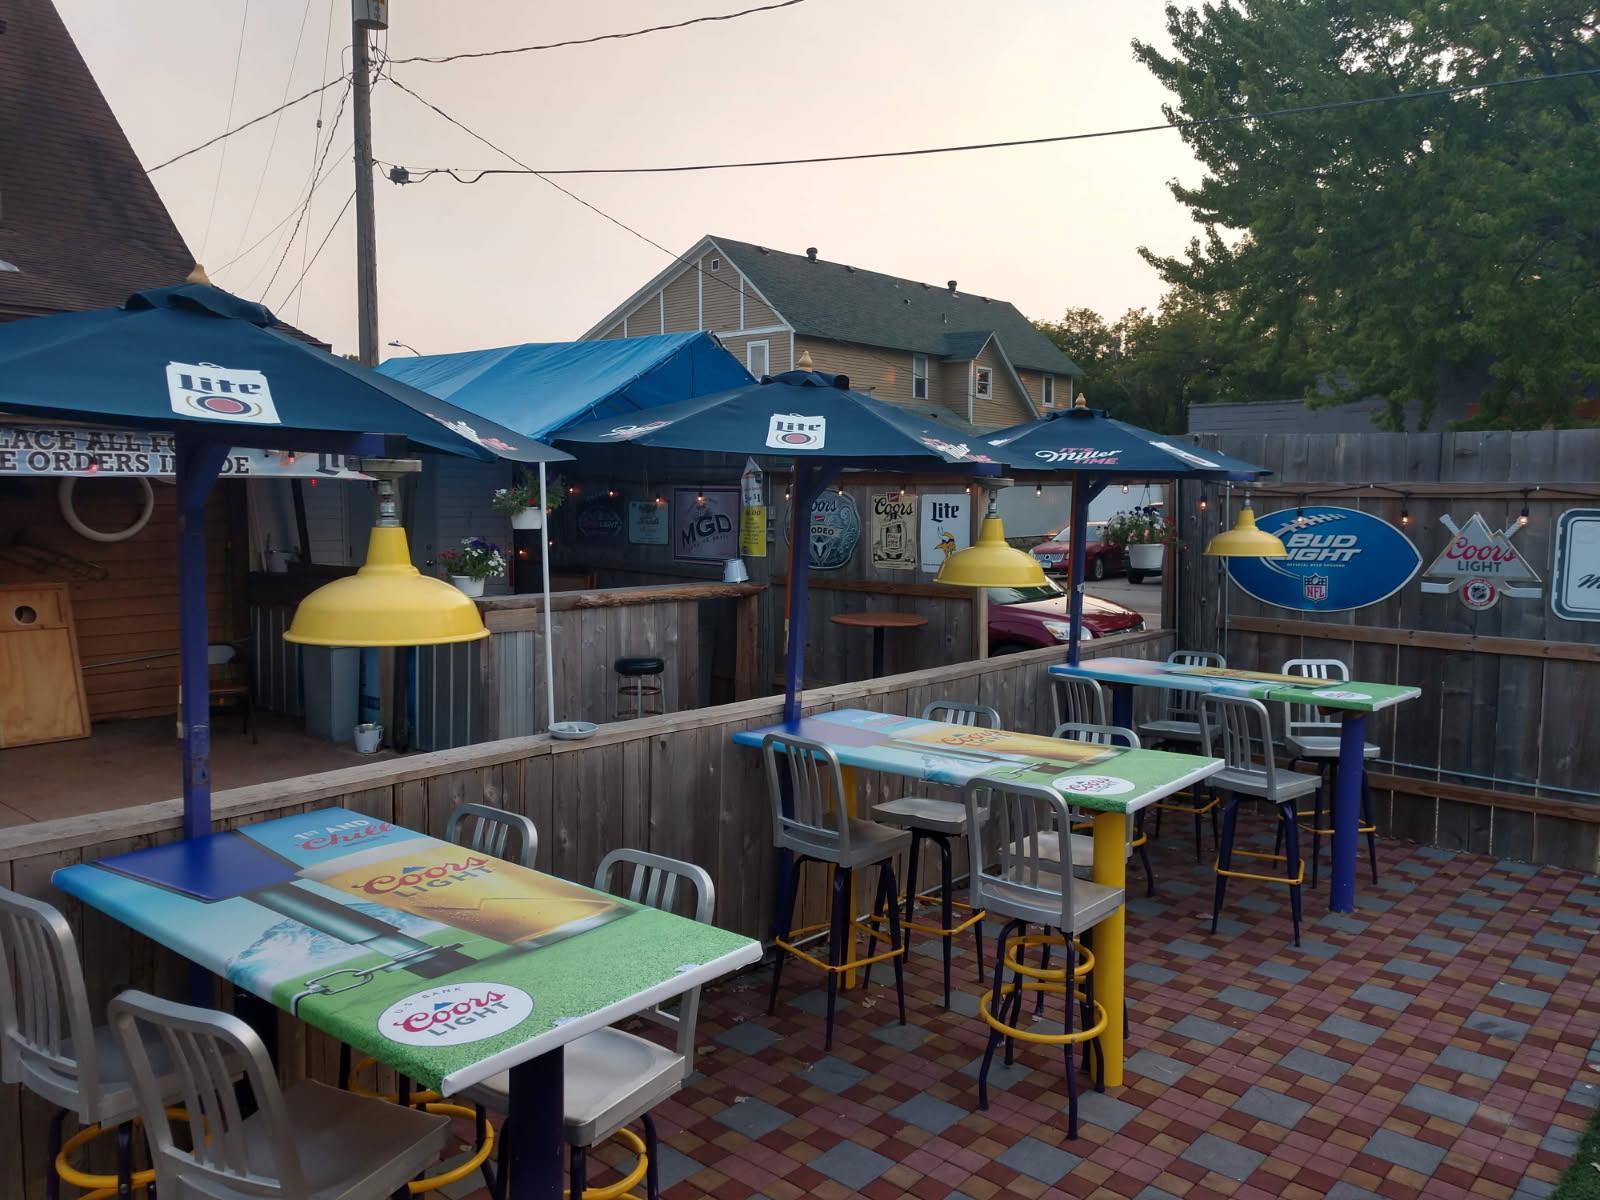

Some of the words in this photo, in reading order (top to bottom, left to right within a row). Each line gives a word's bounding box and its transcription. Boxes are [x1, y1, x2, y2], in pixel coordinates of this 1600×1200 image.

[178, 374, 261, 394] Lite
[776, 421, 822, 432] Lite
[87, 432, 140, 452] ALL
[28, 451, 150, 473] ORDERS
[1034, 449, 1123, 462] Miller
[1073, 457, 1119, 465] TIME
[811, 501, 837, 512] oors
[874, 497, 913, 516] Coors
[931, 502, 960, 523] Lite
[682, 514, 732, 550] MGD
[811, 527, 834, 535] ODEO
[1286, 533, 1358, 548] BUD
[1446, 537, 1517, 562] Coors
[1457, 561, 1502, 572] LIGHT
[1306, 585, 1325, 598] NFL
[326, 819, 370, 833] AND
[351, 856, 489, 894] Coors
[393, 866, 493, 897] LIGHT
[392, 991, 506, 1033] Coors
[426, 1001, 509, 1036] LIGHT
